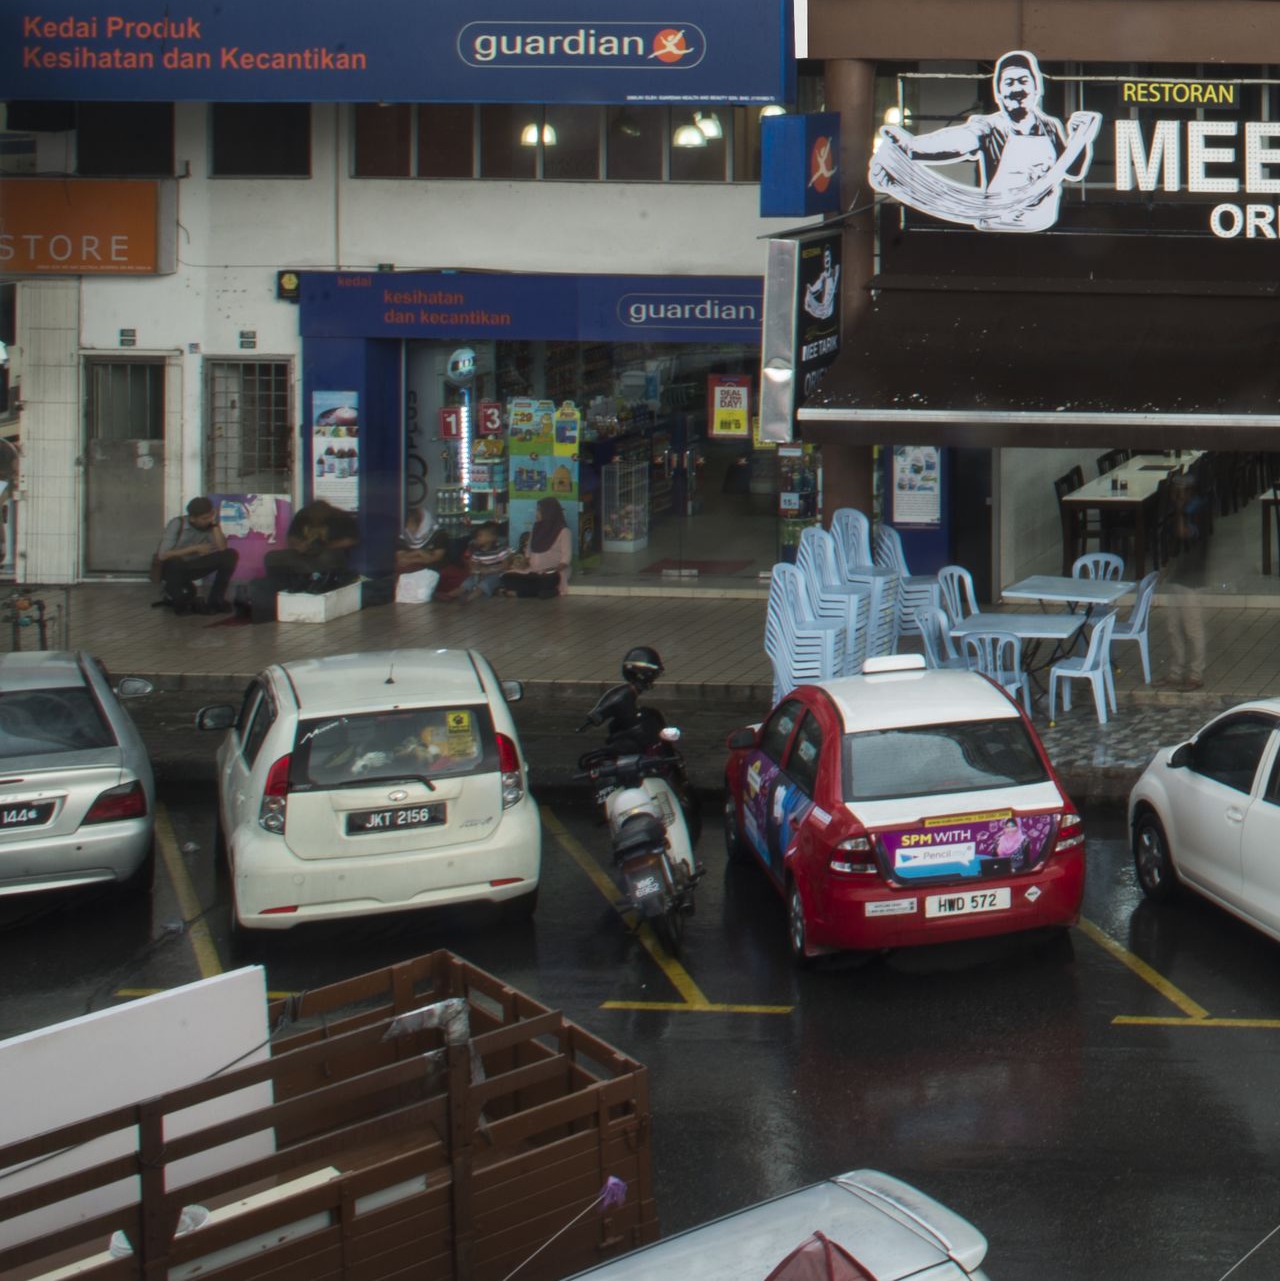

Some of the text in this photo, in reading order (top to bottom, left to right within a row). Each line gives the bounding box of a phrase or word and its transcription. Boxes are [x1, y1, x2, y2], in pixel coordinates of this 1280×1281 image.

[23, 17, 202, 39] Kedai Produk
[474, 29, 644, 61] guardian
[23, 46, 367, 70] Kesihatan dan Kecantikan
[1123, 83, 1235, 105] RESTORAN
[0, 234, 129, 261] STORE
[384, 289, 465, 305] kesihatan
[384, 309, 512, 326] dan kecantikan
[629, 299, 756, 324] guardian
[366, 809, 430, 828] JKT 2156
[901, 829, 972, 847] SPM WITH
[923, 847, 954, 860] Pencil
[938, 891, 998, 913] HWD 572
